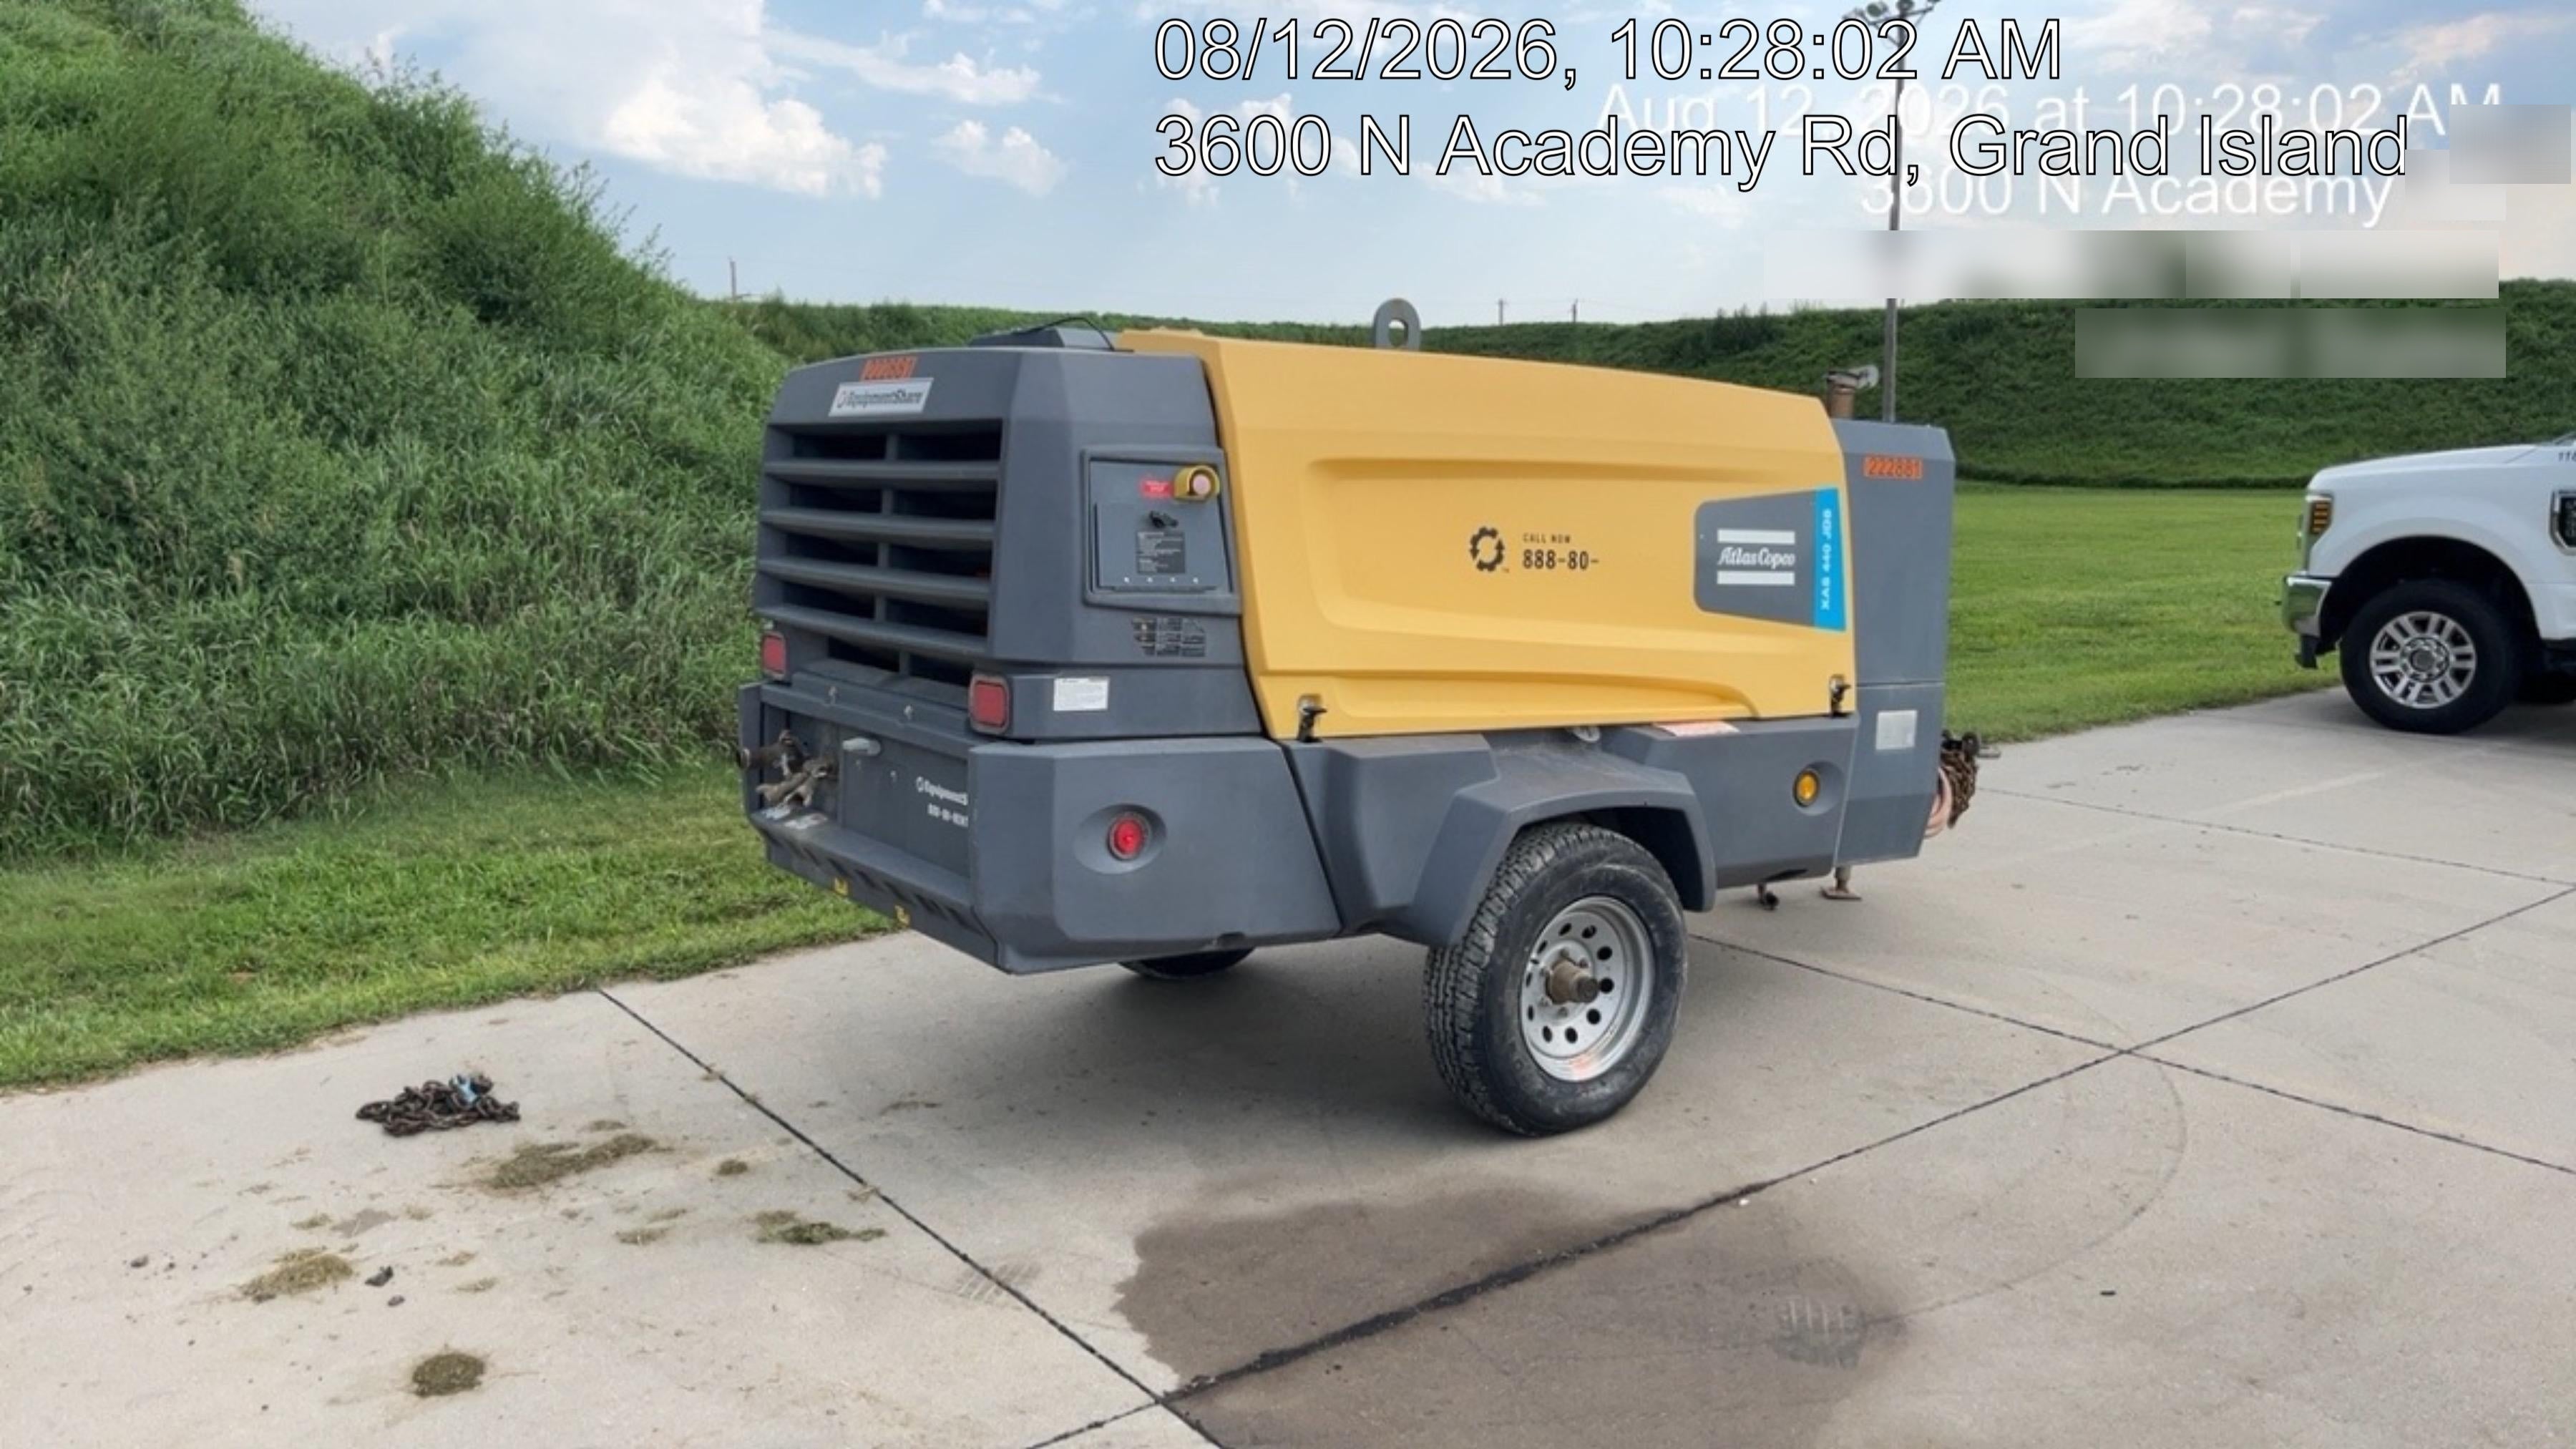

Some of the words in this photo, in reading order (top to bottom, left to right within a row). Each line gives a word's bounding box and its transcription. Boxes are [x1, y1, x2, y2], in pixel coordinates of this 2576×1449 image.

[1522, 532, 1547, 544] CALL
[1551, 534, 1571, 544] NOW
[1522, 548, 1600, 570] 888-80-
[1821, 542, 1833, 573] 440
[1820, 577, 1831, 611] XAS
